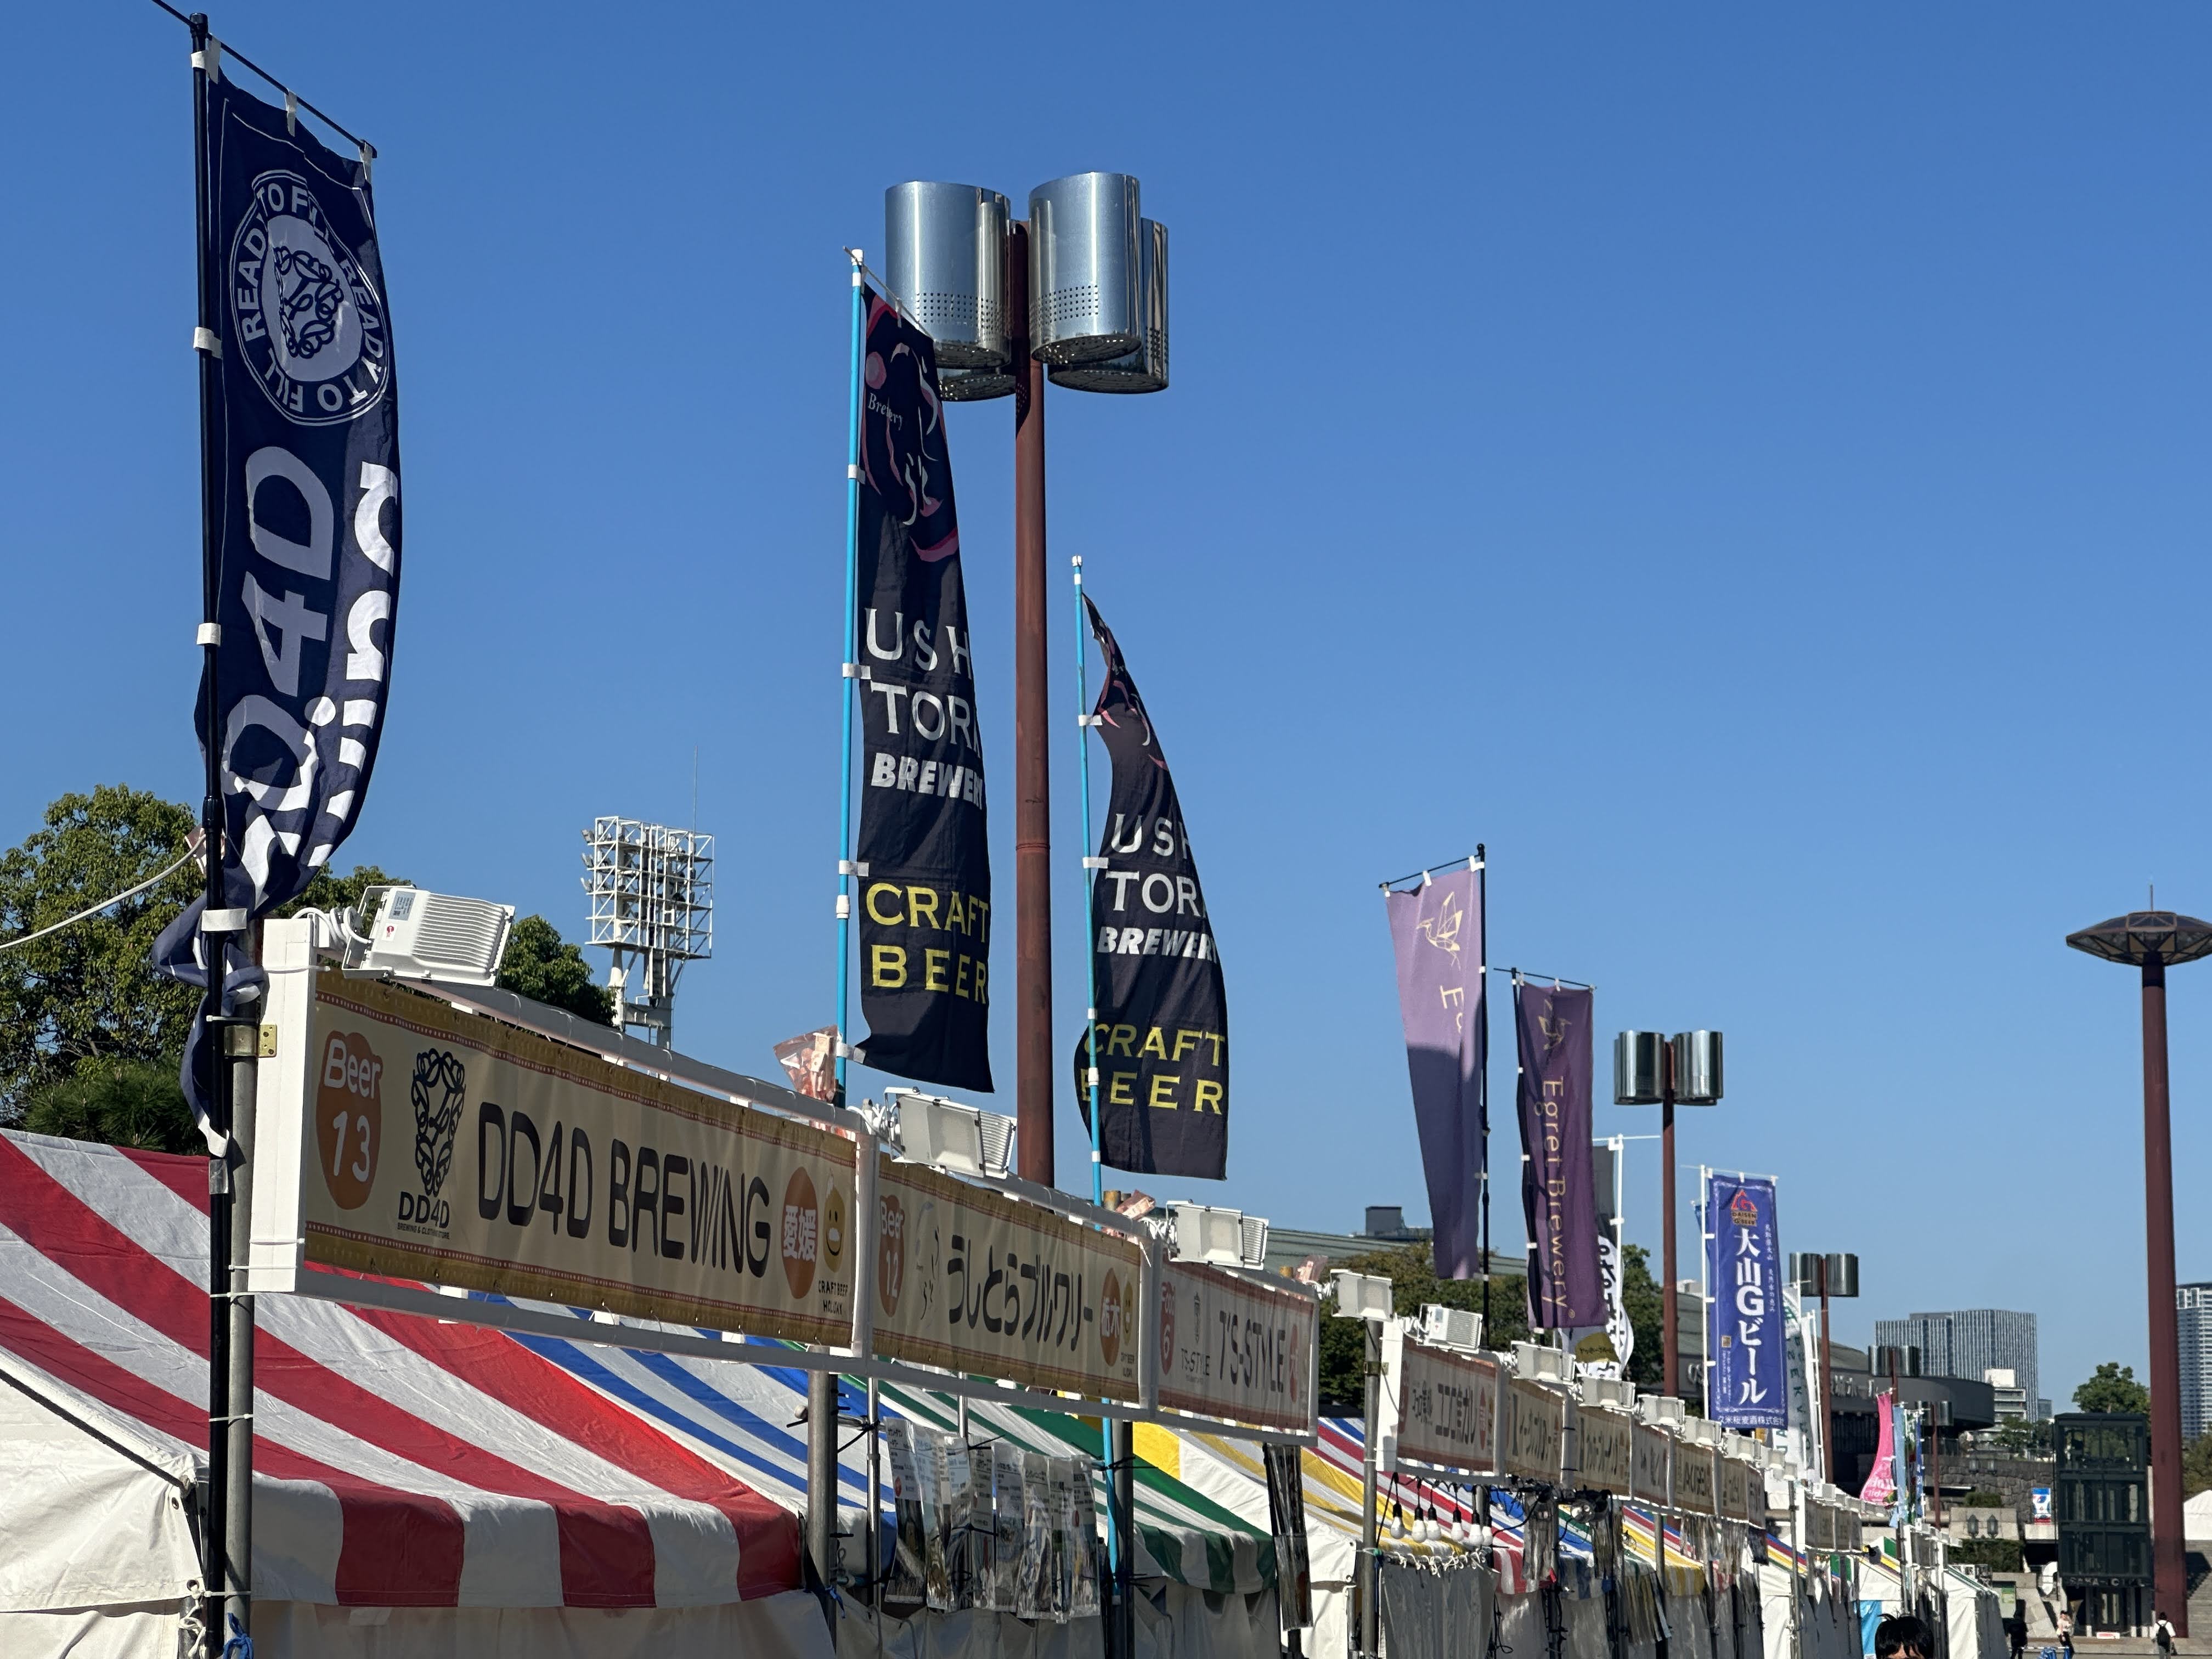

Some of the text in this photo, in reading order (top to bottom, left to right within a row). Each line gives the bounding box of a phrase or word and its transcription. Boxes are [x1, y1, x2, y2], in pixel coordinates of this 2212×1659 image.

[265, 259, 383, 413] READY TO FILL
[866, 883, 989, 943] CRAFT
[1105, 871, 1206, 918] TOR
[871, 945, 986, 1004] BEER
[324, 1039, 381, 1099] Beer
[1084, 1024, 1226, 1066] CRAFT
[333, 1111, 370, 1183] 13
[1534, 1076, 1564, 1167] Egret
[398, 1192, 449, 1228] DD4D
[479, 1102, 592, 1239] DD4D
[609, 1139, 771, 1278] BREWING
[783, 1205, 816, 1262] 愛媛
[1542, 1176, 1567, 1308] Brewery
[886, 1250, 898, 1299] 12
[948, 1234, 1093, 1351] うしとらブルワリー
[1164, 1324, 1171, 1360] 6
[1734, 1228, 1768, 1406] 大山Gビール
